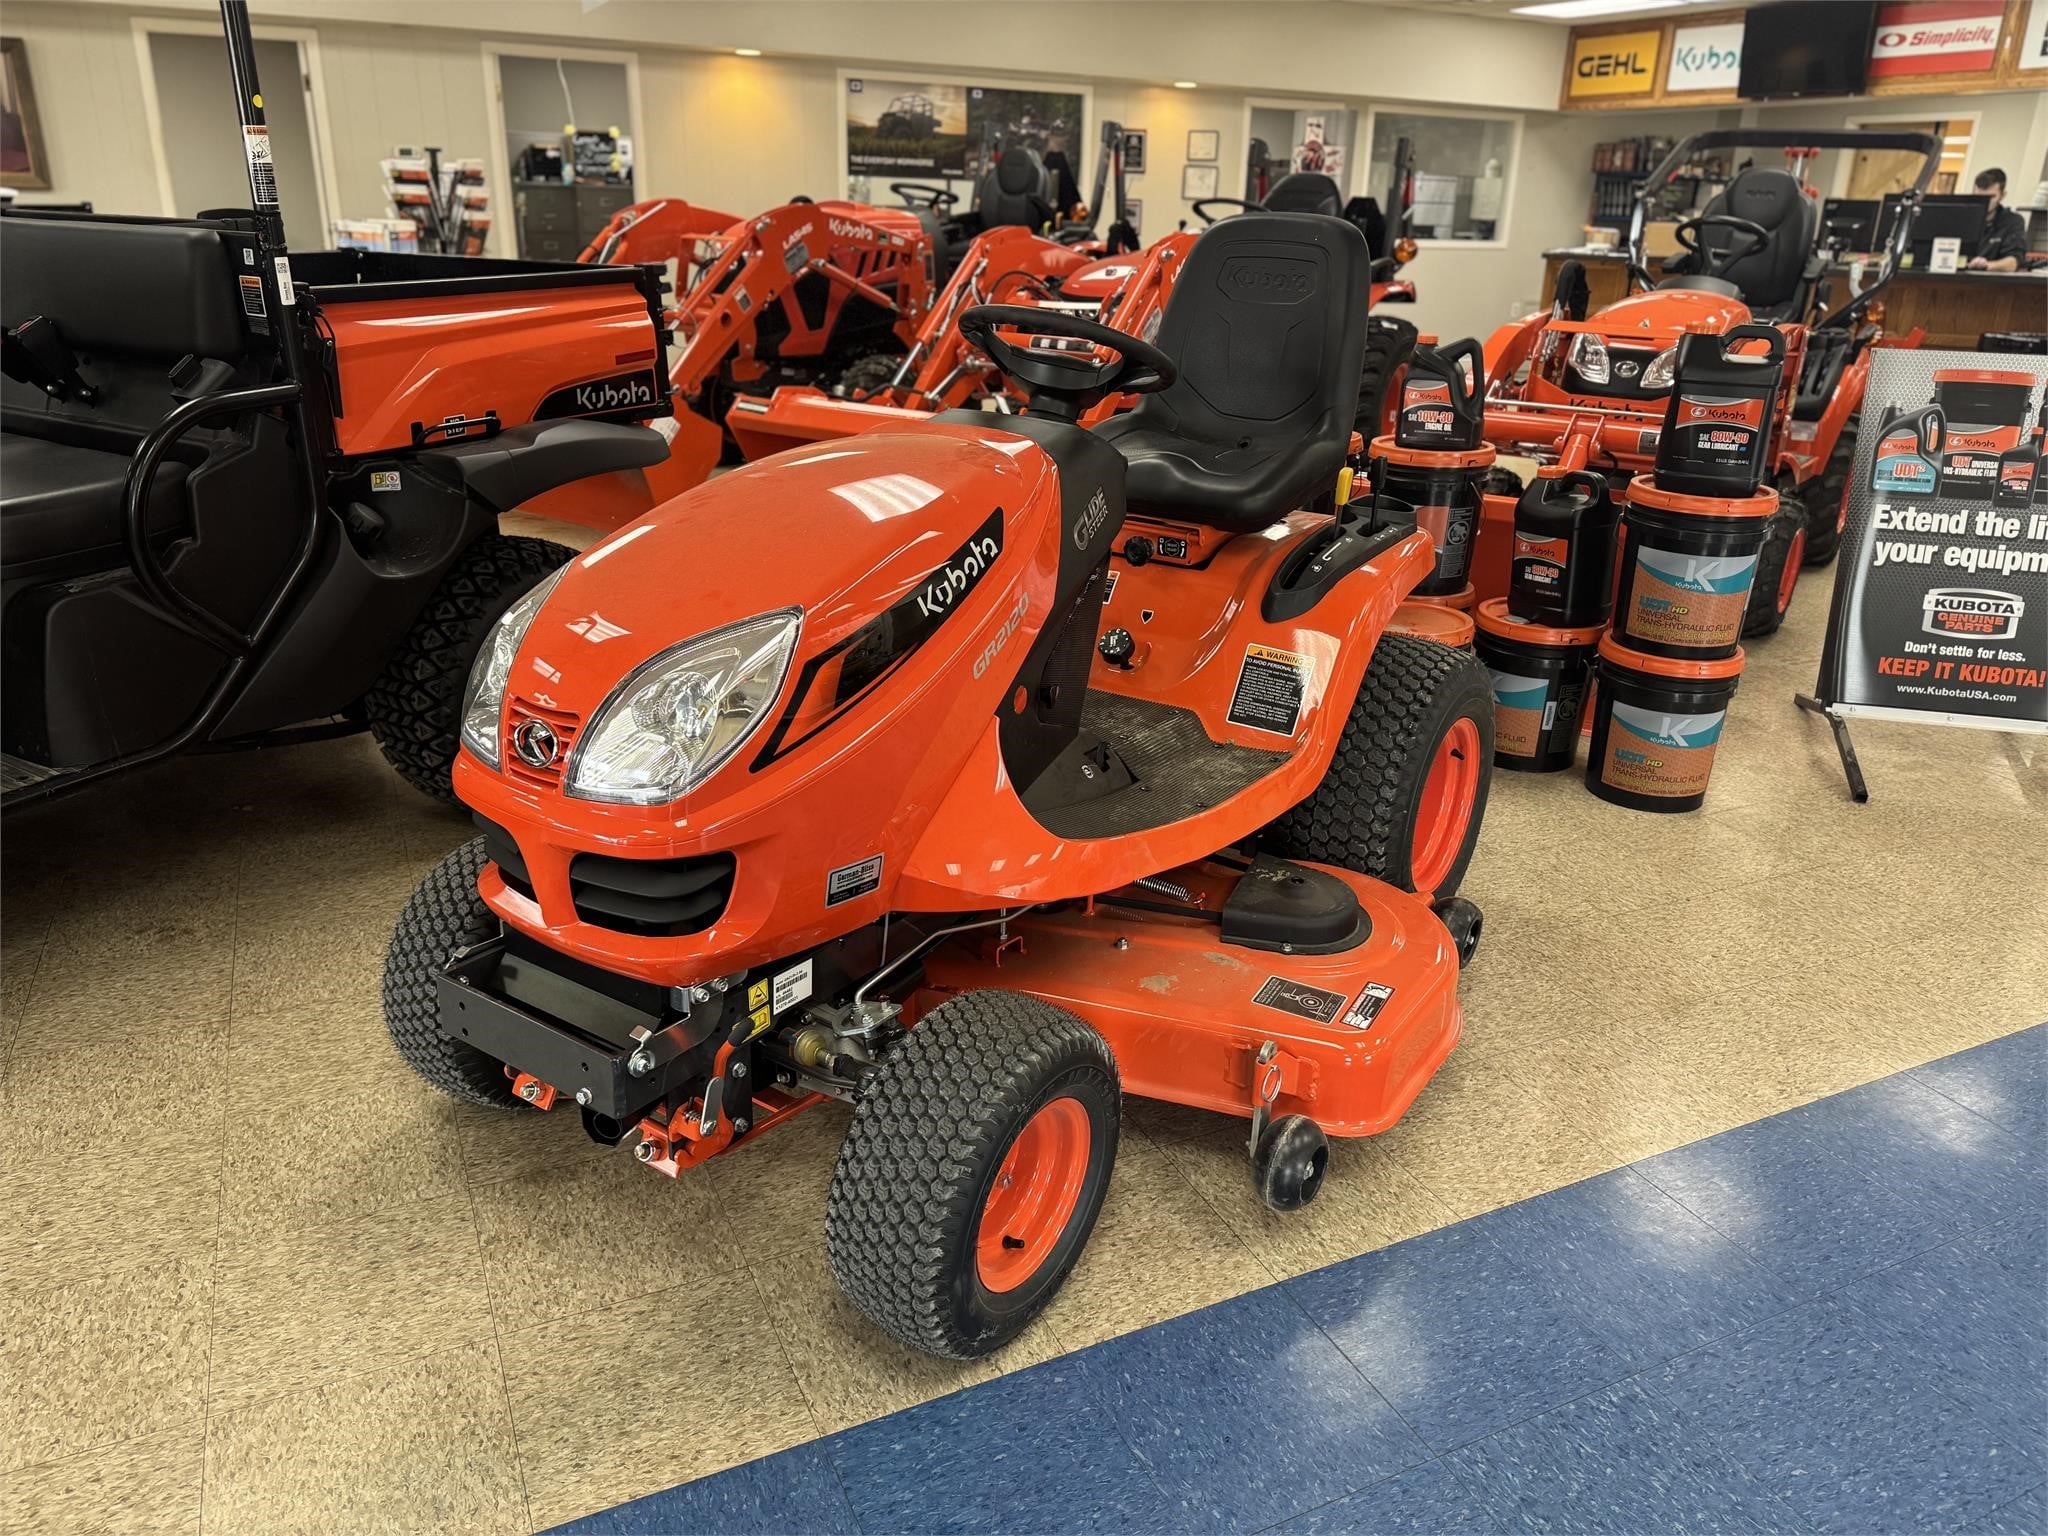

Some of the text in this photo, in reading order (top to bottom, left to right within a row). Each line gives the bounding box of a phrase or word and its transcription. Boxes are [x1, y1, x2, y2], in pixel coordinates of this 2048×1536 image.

[1910, 27, 1992, 48] Simplicity
[1577, 52, 1648, 78] GEHL
[1675, 45, 1741, 73] Kubo
[829, 218, 873, 241] Kubota
[576, 381, 650, 409] Kubota
[1419, 393, 1442, 401] Kubota
[1417, 410, 1454, 423] 10W-30
[1708, 409, 1746, 420] Kubota
[1425, 423, 1443, 431] ENGINE
[1711, 431, 1750, 444] 80W-90
[1964, 437, 1995, 448] Kubota
[1952, 456, 1973, 468] UDT
[1089, 505, 1108, 539] STEER
[1872, 503, 1969, 534] Extend
[1975, 511, 2021, 539] the
[1873, 541, 2048, 576] your equipm
[916, 537, 998, 617] Kubota
[1671, 606, 1688, 615] HD
[1934, 598, 2015, 614] KUBOTA
[1637, 608, 1681, 622] UNIVERSAL
[1937, 612, 2005, 626] GENUINE
[1637, 615, 1715, 632] TRANS-HYDRAULIC
[1944, 622, 1994, 633] PARTS
[972, 591, 1029, 680] GR2120
[1265, 651, 1305, 665] WARNING
[1904, 641, 2026, 662] Don't settle for less.
[1877, 656, 2047, 688] KEEP IT KUBOTA!
[1896, 684, 2017, 703] www.KubotaUSA.com
[1613, 760, 1657, 775] UNIVERSAL
[1646, 759, 1663, 768] HD
[1612, 766, 1688, 783] TRANS-HYDRAULIC
